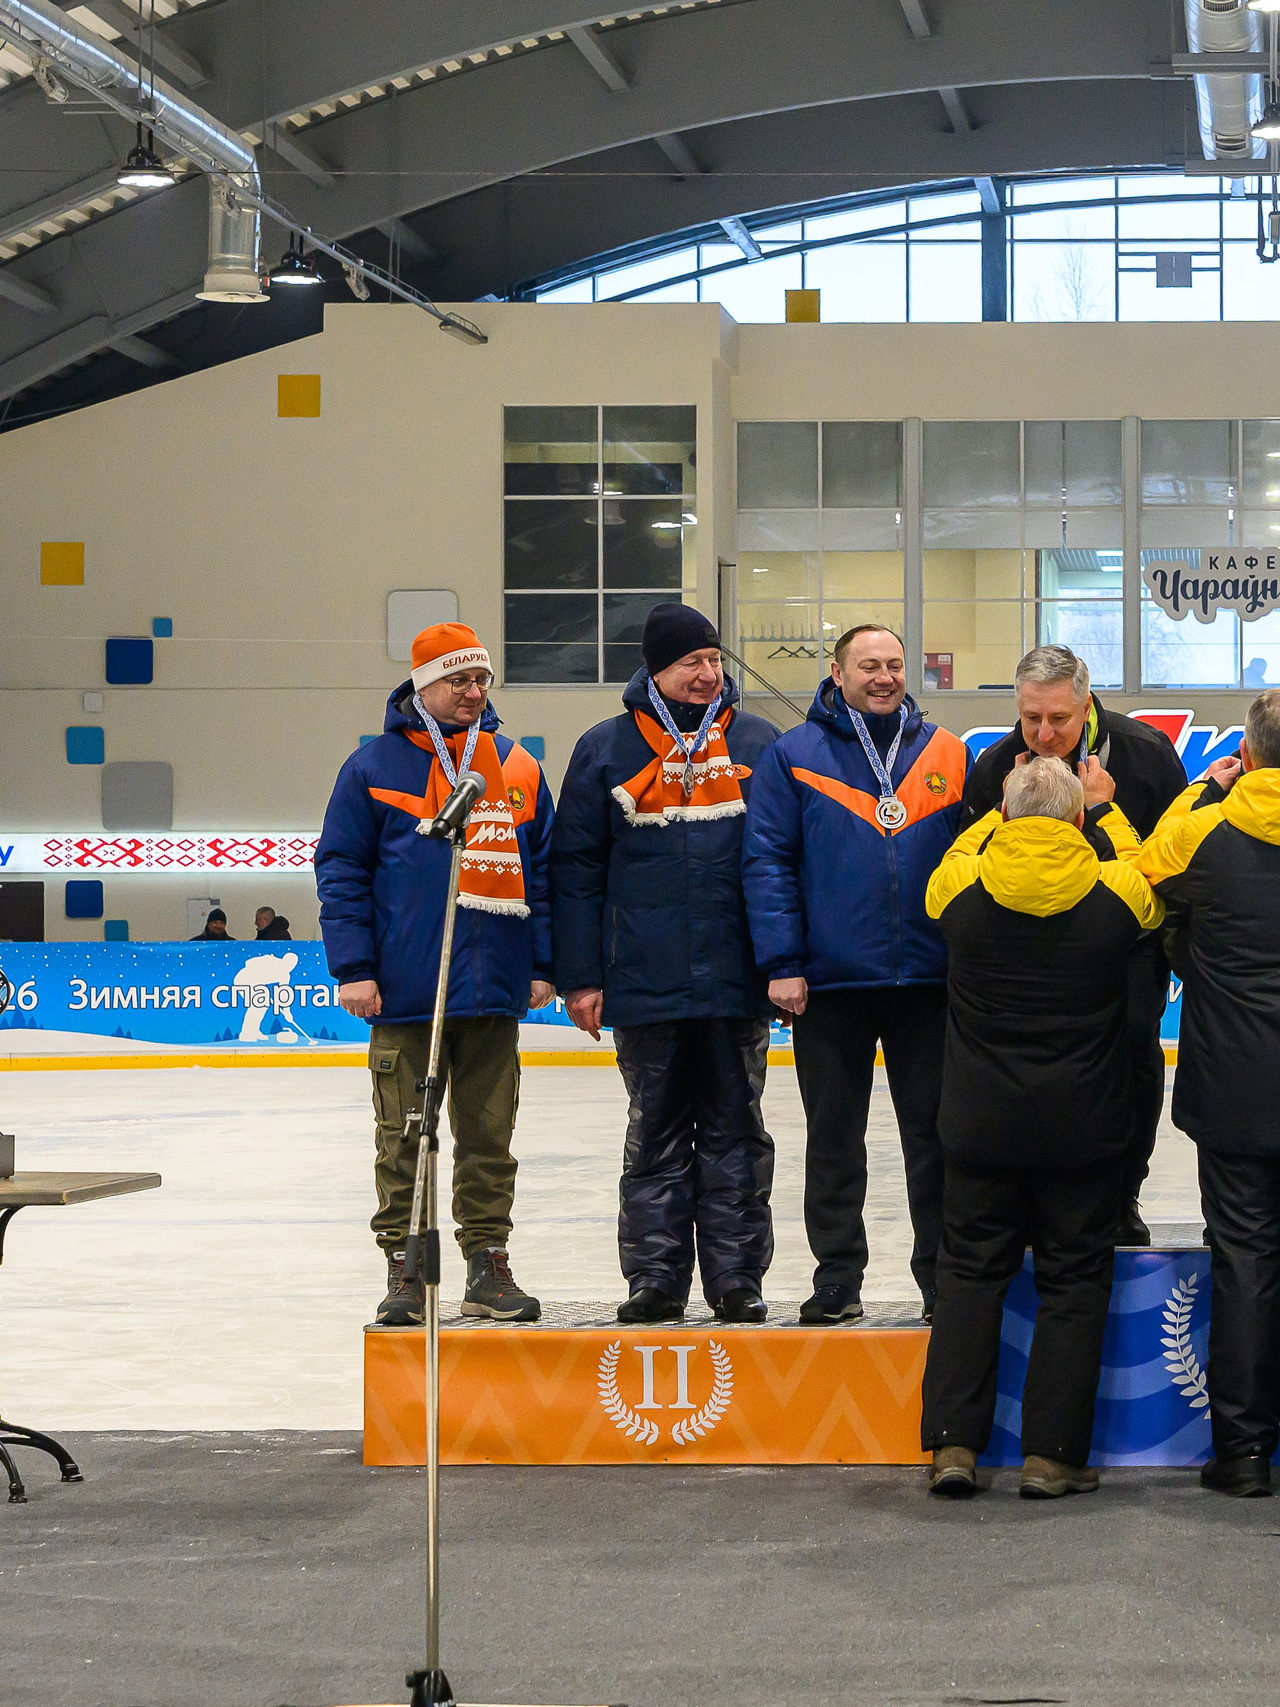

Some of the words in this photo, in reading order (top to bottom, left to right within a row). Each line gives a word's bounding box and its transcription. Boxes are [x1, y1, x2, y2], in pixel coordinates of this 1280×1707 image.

[1209, 555, 1276, 570] КАФЕ
[68, 979, 201, 1010] Зимняя
[633, 1345, 698, 1409] II
